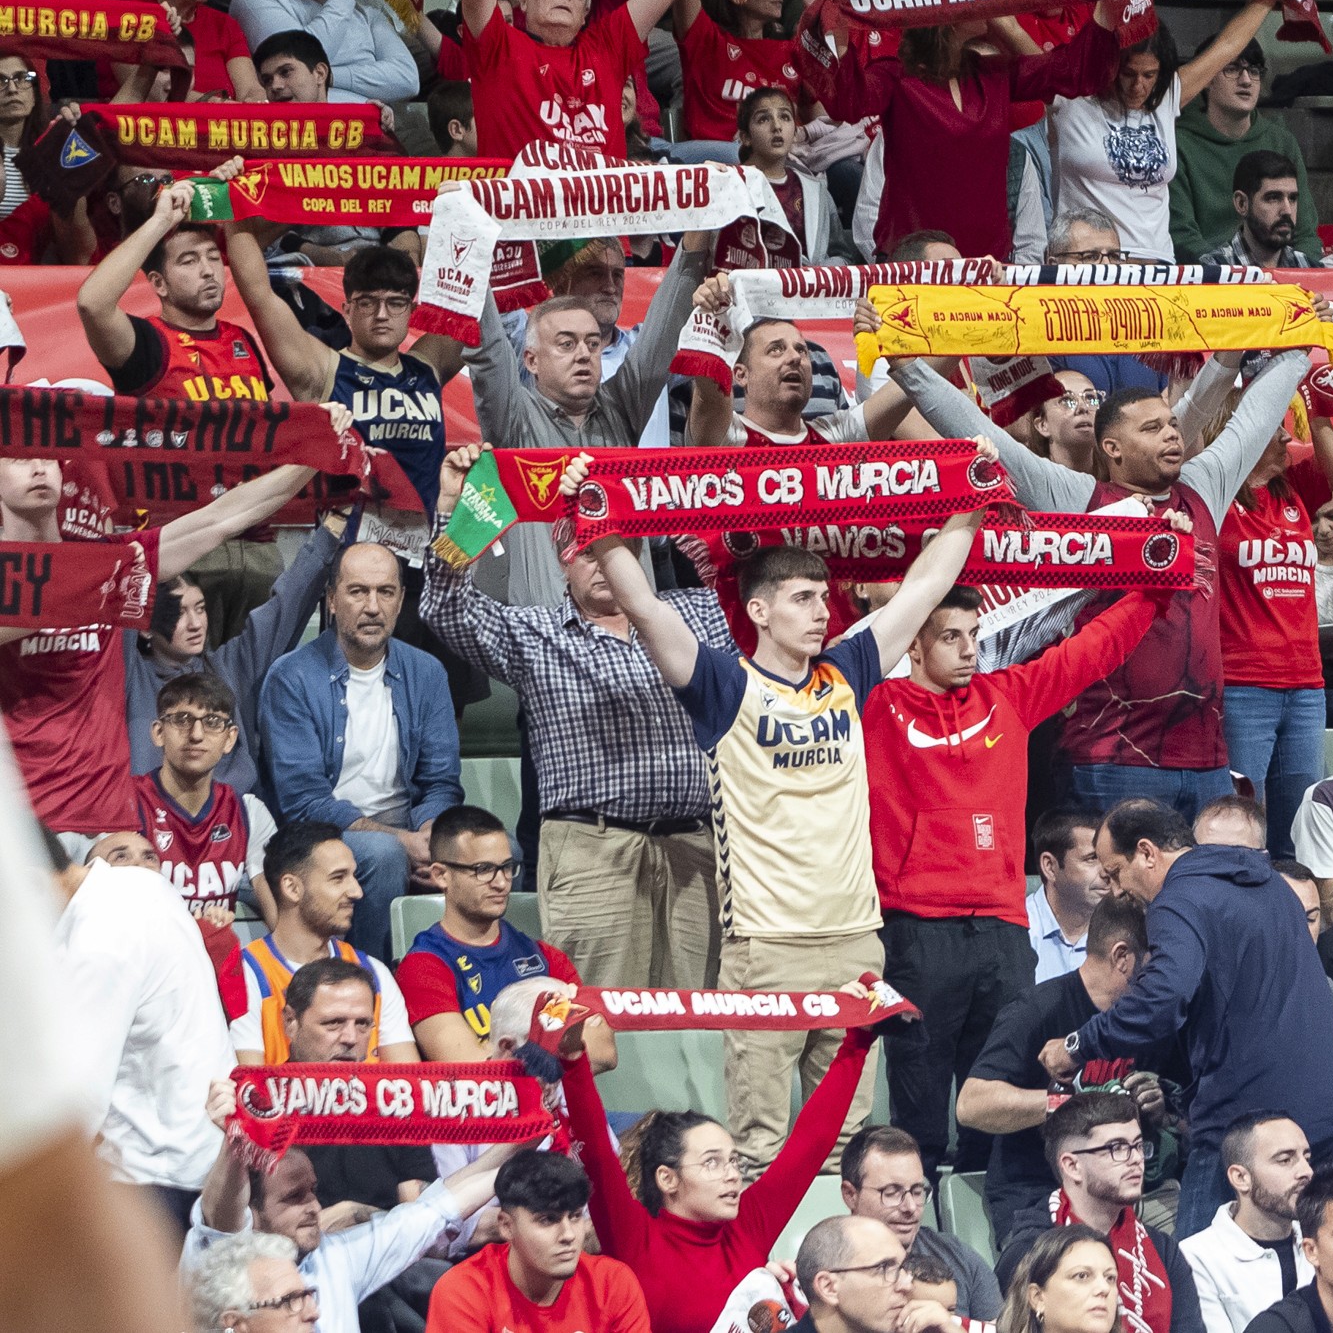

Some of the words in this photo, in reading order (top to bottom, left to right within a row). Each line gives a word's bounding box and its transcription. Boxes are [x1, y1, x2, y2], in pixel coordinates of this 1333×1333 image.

[116, 113, 198, 151] UCAM
[207, 118, 318, 152] MURCIA
[327, 120, 364, 152] CB
[469, 174, 557, 221] UCAM
[561, 167, 671, 219] MURCIA
[675, 166, 711, 210] CB
[539, 219, 568, 232] COPA
[572, 218, 592, 230] DEL
[601, 216, 621, 229] REY
[623, 214, 648, 227] 2024
[352, 387, 442, 424] UCAM
[368, 421, 432, 443] MURCIA
[622, 468, 745, 512] VAMOS
[756, 466, 804, 504] CB
[816, 458, 941, 504] MURCIA
[756, 709, 851, 749] UCAM
[773, 746, 842, 771] MURCIA
[602, 990, 684, 1015] UCAM
[693, 991, 796, 1017] MURCIA
[802, 993, 839, 1017] CB
[268, 1077, 366, 1116] VAMOS
[376, 1078, 414, 1116] CB
[422, 1078, 519, 1118] MURCIA
